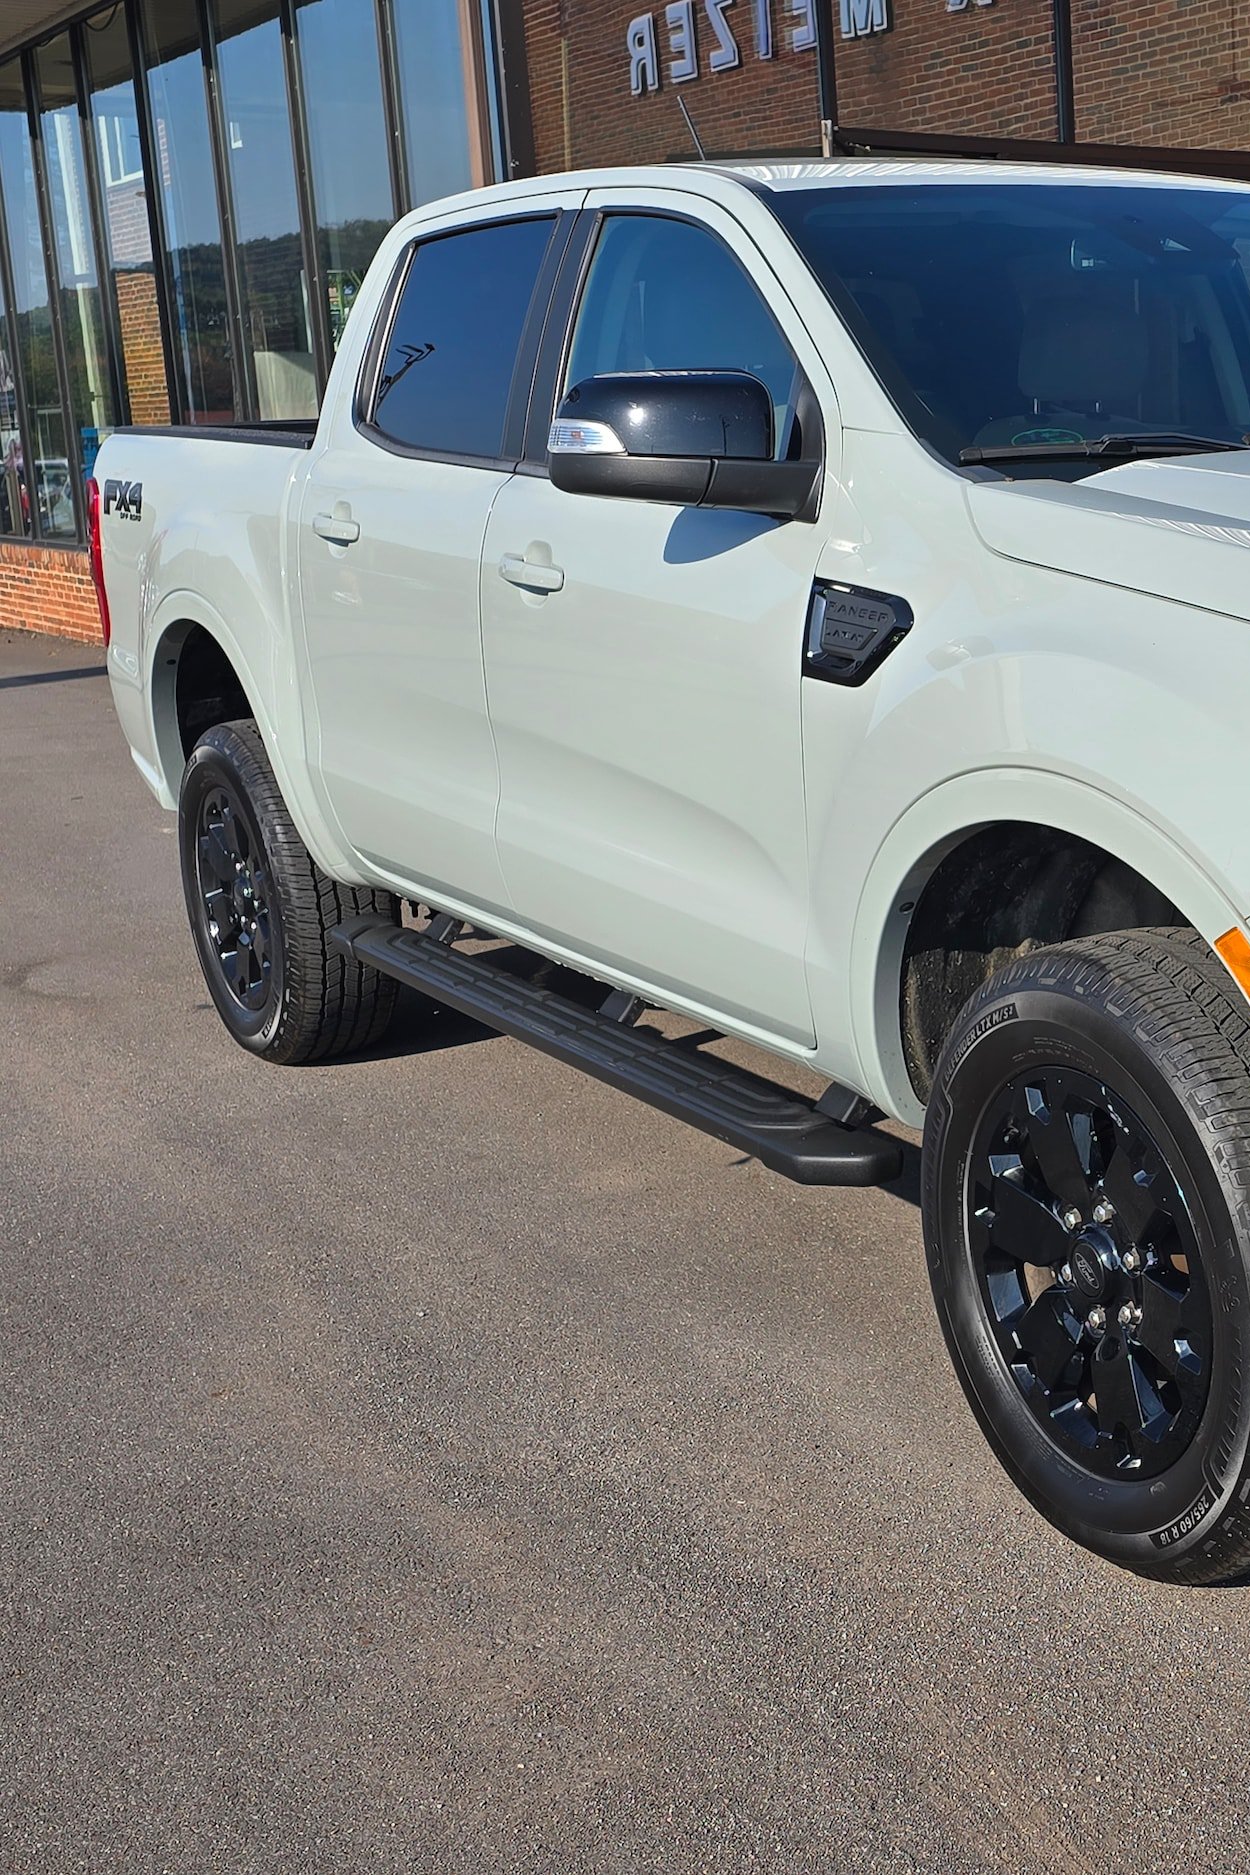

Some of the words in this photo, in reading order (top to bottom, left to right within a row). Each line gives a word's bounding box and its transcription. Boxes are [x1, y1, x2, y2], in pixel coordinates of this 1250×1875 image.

[104, 479, 142, 514] FX4
[827, 600, 889, 623] RANGER
[975, 1014, 992, 1037] LTX
[1179, 1494, 1210, 1534] 265/60
[1160, 1531, 1172, 1546] 18
[1171, 1525, 1180, 1540] R
